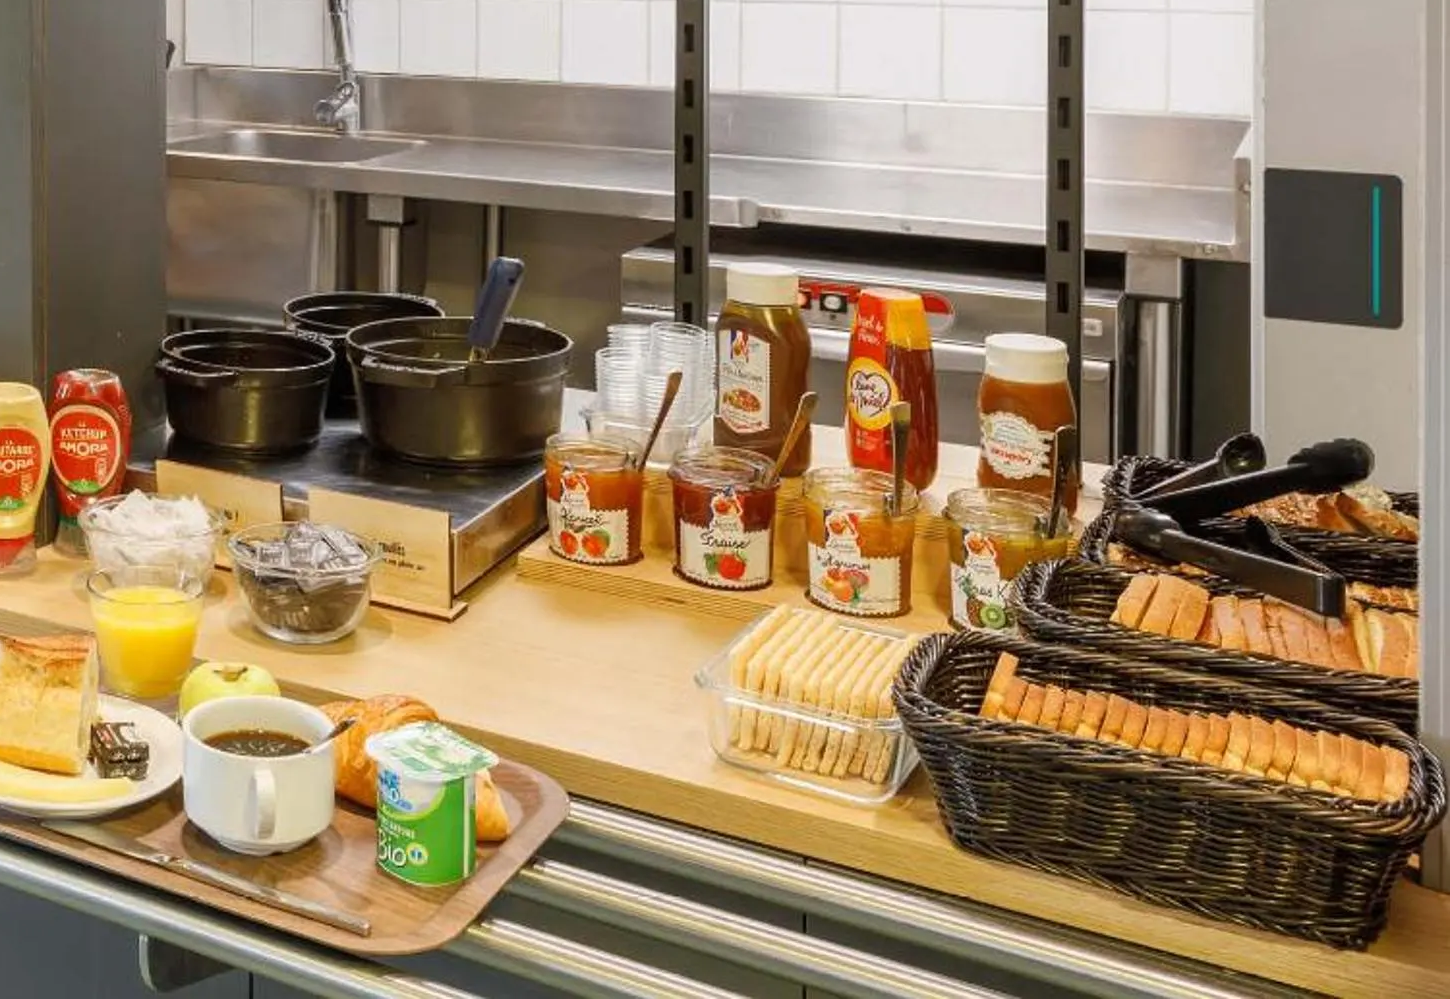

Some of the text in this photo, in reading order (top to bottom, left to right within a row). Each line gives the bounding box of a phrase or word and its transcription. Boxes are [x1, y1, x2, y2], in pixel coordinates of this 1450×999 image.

[61, 428, 107, 440] KETCHUP
[59, 441, 108, 457] AMORA
[700, 529, 751, 549] Fraise
[378, 827, 407, 867] Bio
